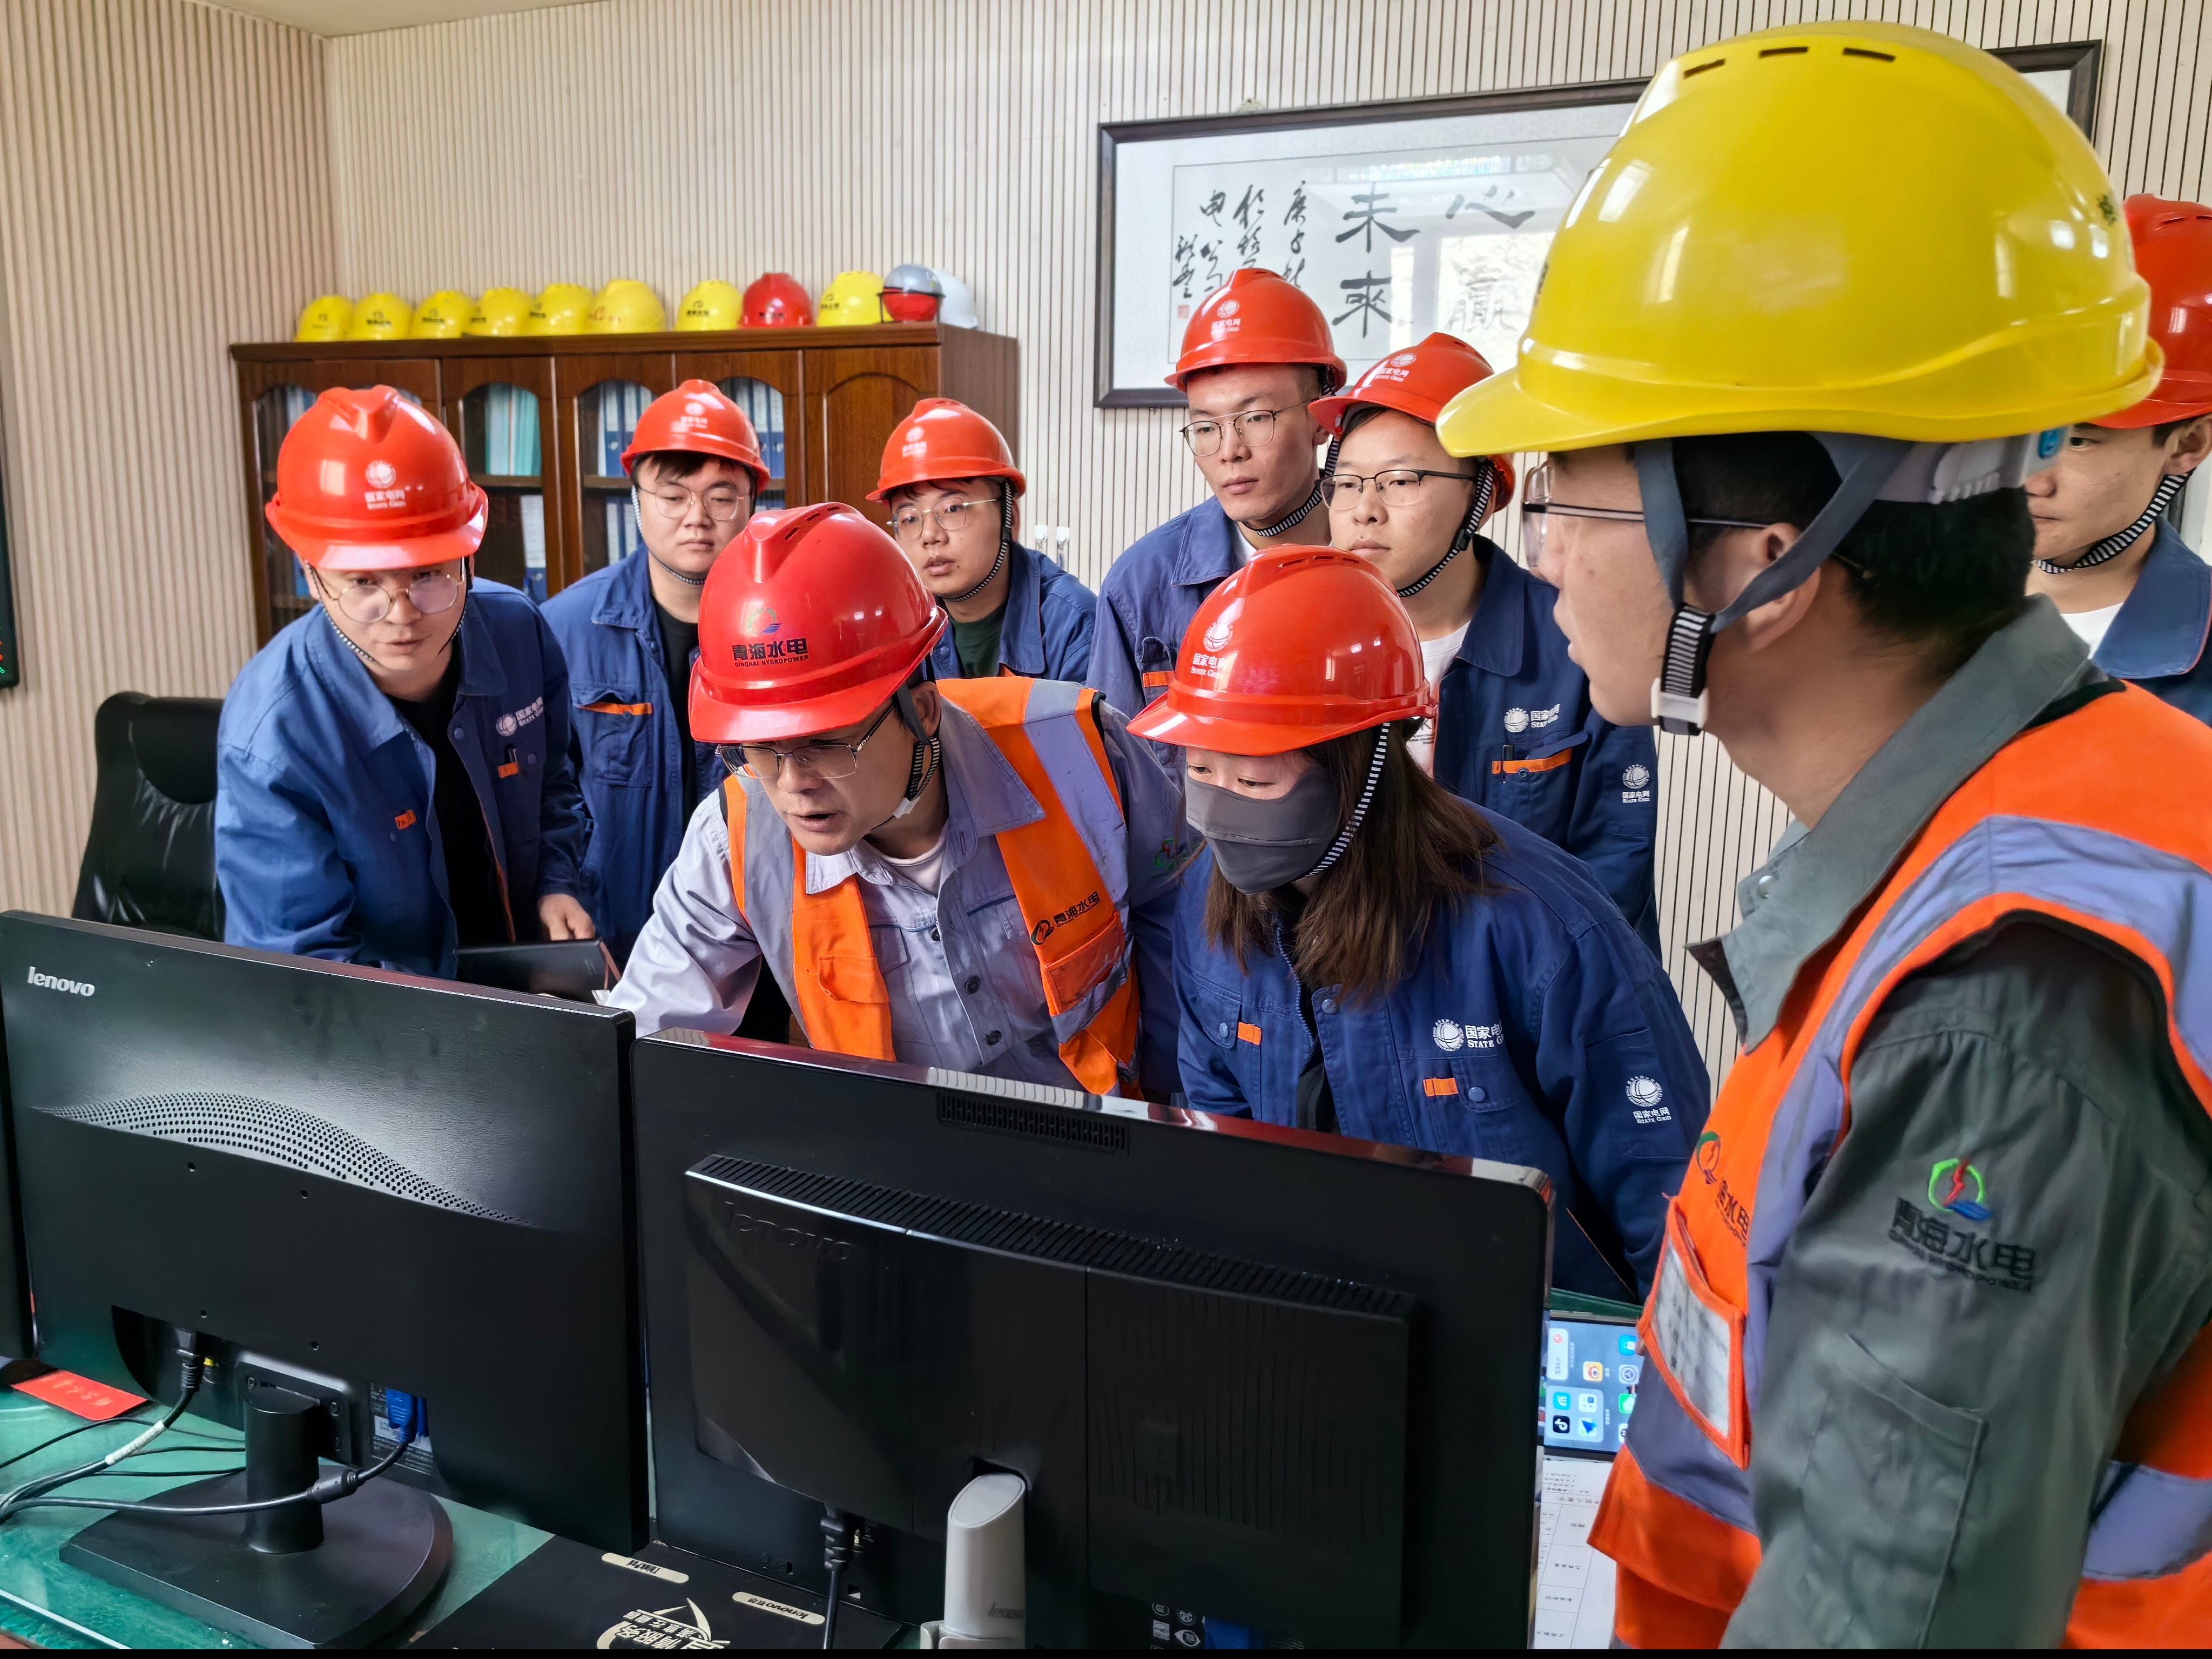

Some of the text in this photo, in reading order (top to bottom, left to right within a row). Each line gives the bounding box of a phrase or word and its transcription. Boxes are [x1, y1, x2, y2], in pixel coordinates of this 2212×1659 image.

[732, 638, 809, 660] 青海水电
[761, 655, 810, 666] HYDROPOWER
[28, 966, 95, 997] lenovo
[1465, 1023, 1502, 1040] 国家电
[1467, 1039, 1495, 1048] STATE
[1633, 1107, 1670, 1119] 国家电网
[1892, 1196, 2036, 1280] 青海水电
[766, 1602, 810, 1620] lenovo
